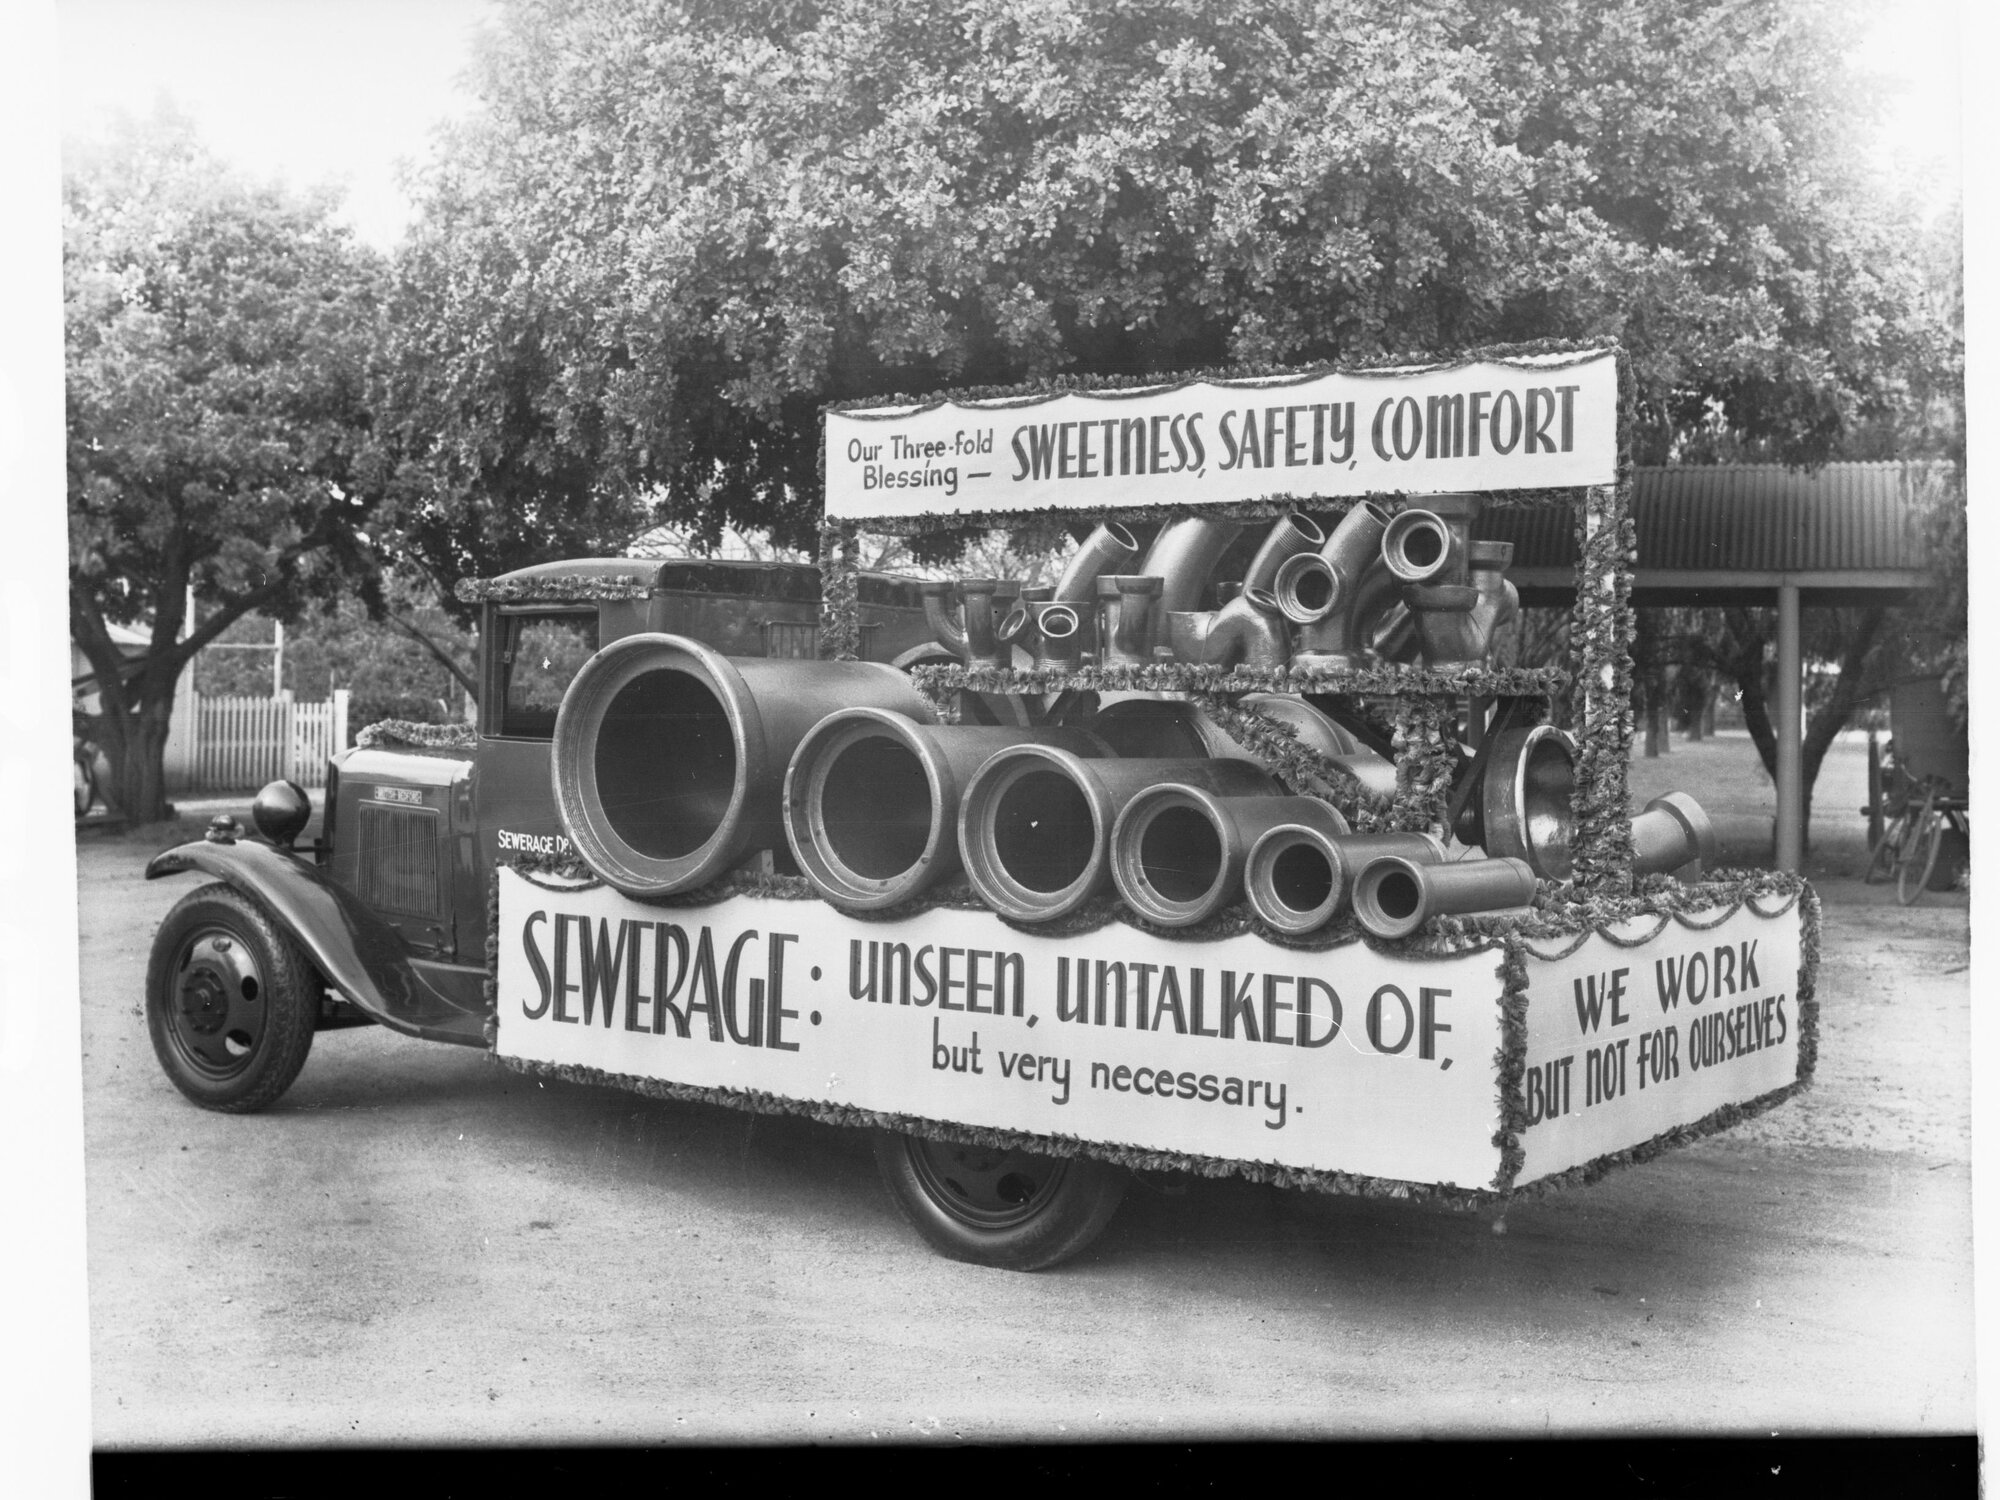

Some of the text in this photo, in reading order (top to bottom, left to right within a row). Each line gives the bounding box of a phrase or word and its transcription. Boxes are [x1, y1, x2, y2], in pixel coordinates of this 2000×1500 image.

[847, 428, 994, 463] Our Three-fold
[863, 460, 959, 497] Blessing
[1011, 385, 1581, 482] SWEETNESS, SAFETY, COMFORT
[497, 828, 555, 855] SEWERAGE
[522, 910, 1455, 1071] SEWERAGE: UNSEEN, UNTALKED OF,
[1573, 938, 1761, 1036] WE WORK
[932, 1016, 1304, 1131] but very necessary.
[1526, 993, 1788, 1128] BUT NOT FOR OURSELVES
